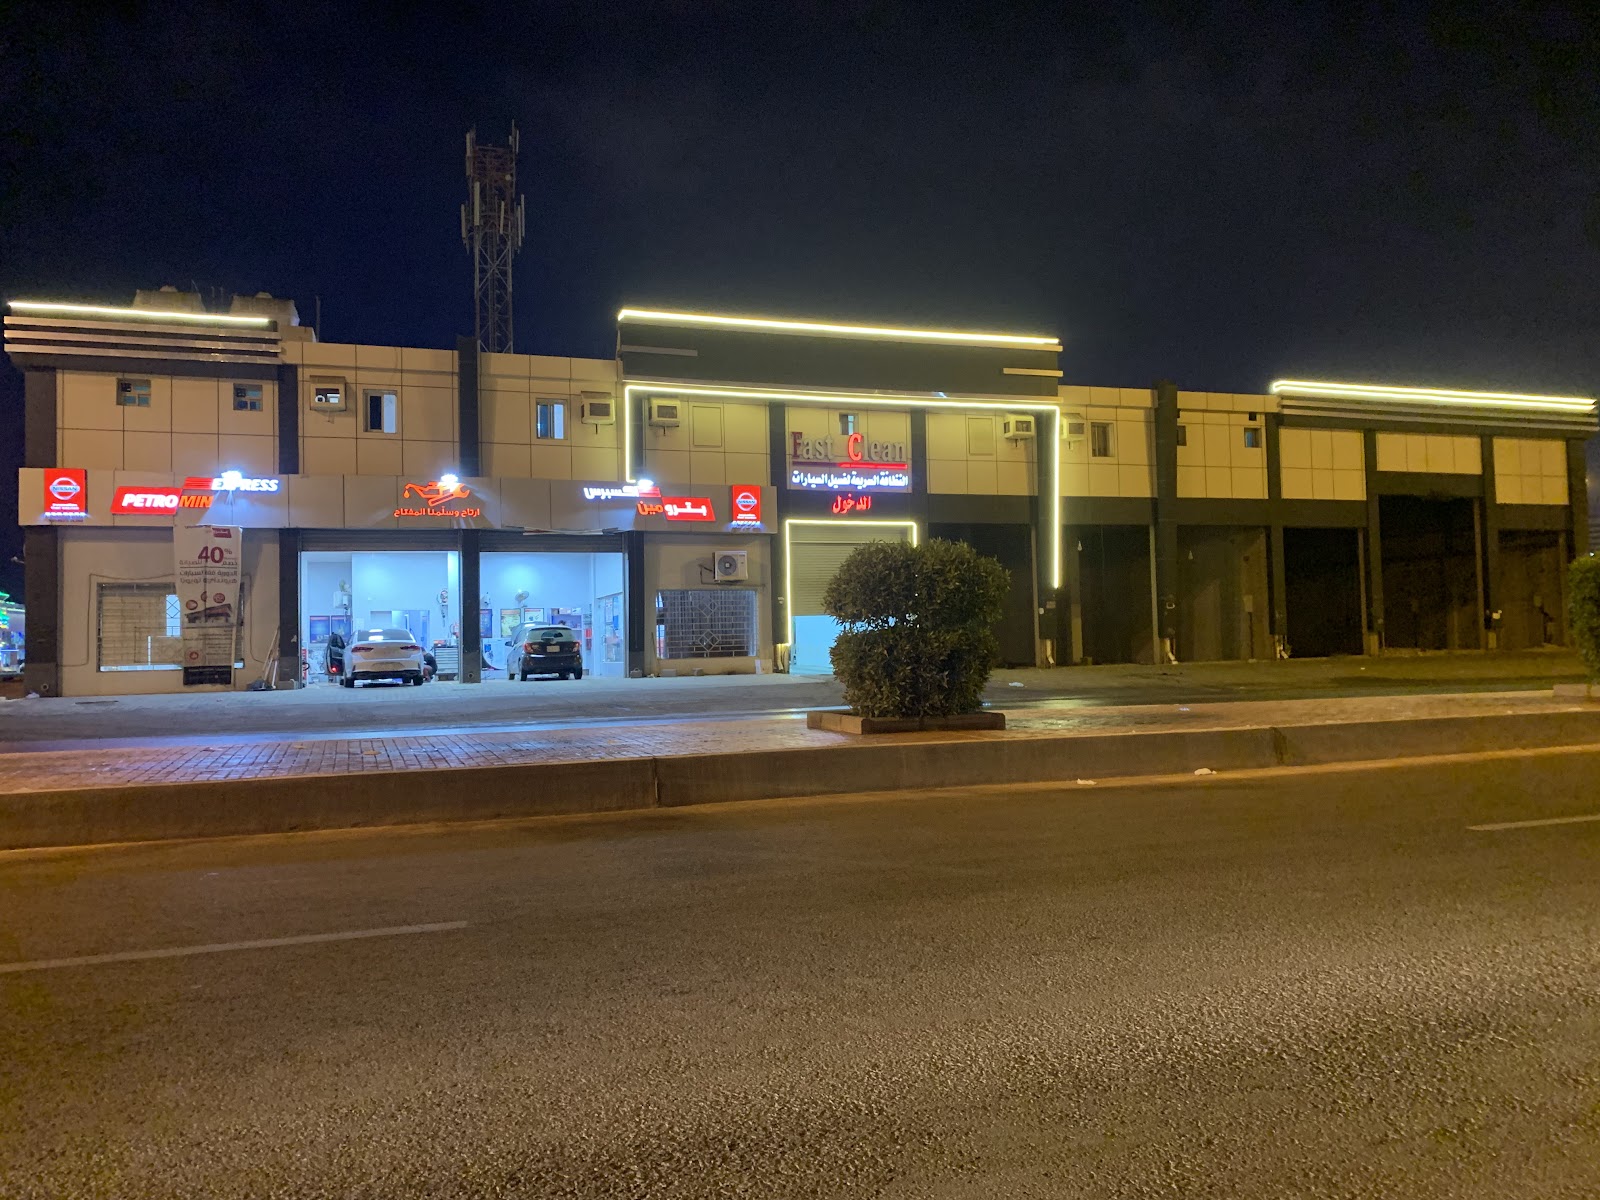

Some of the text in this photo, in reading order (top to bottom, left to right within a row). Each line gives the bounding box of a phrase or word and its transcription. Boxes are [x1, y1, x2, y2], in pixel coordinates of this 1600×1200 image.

[791, 431, 907, 462] Fast Clean
[791, 470, 828, 488] السيارات
[827, 472, 851, 489] لغسيل
[851, 471, 880, 490] السريعة
[393, 508, 426, 518] المفتاح
[461, 508, 480, 518] ارتاح
